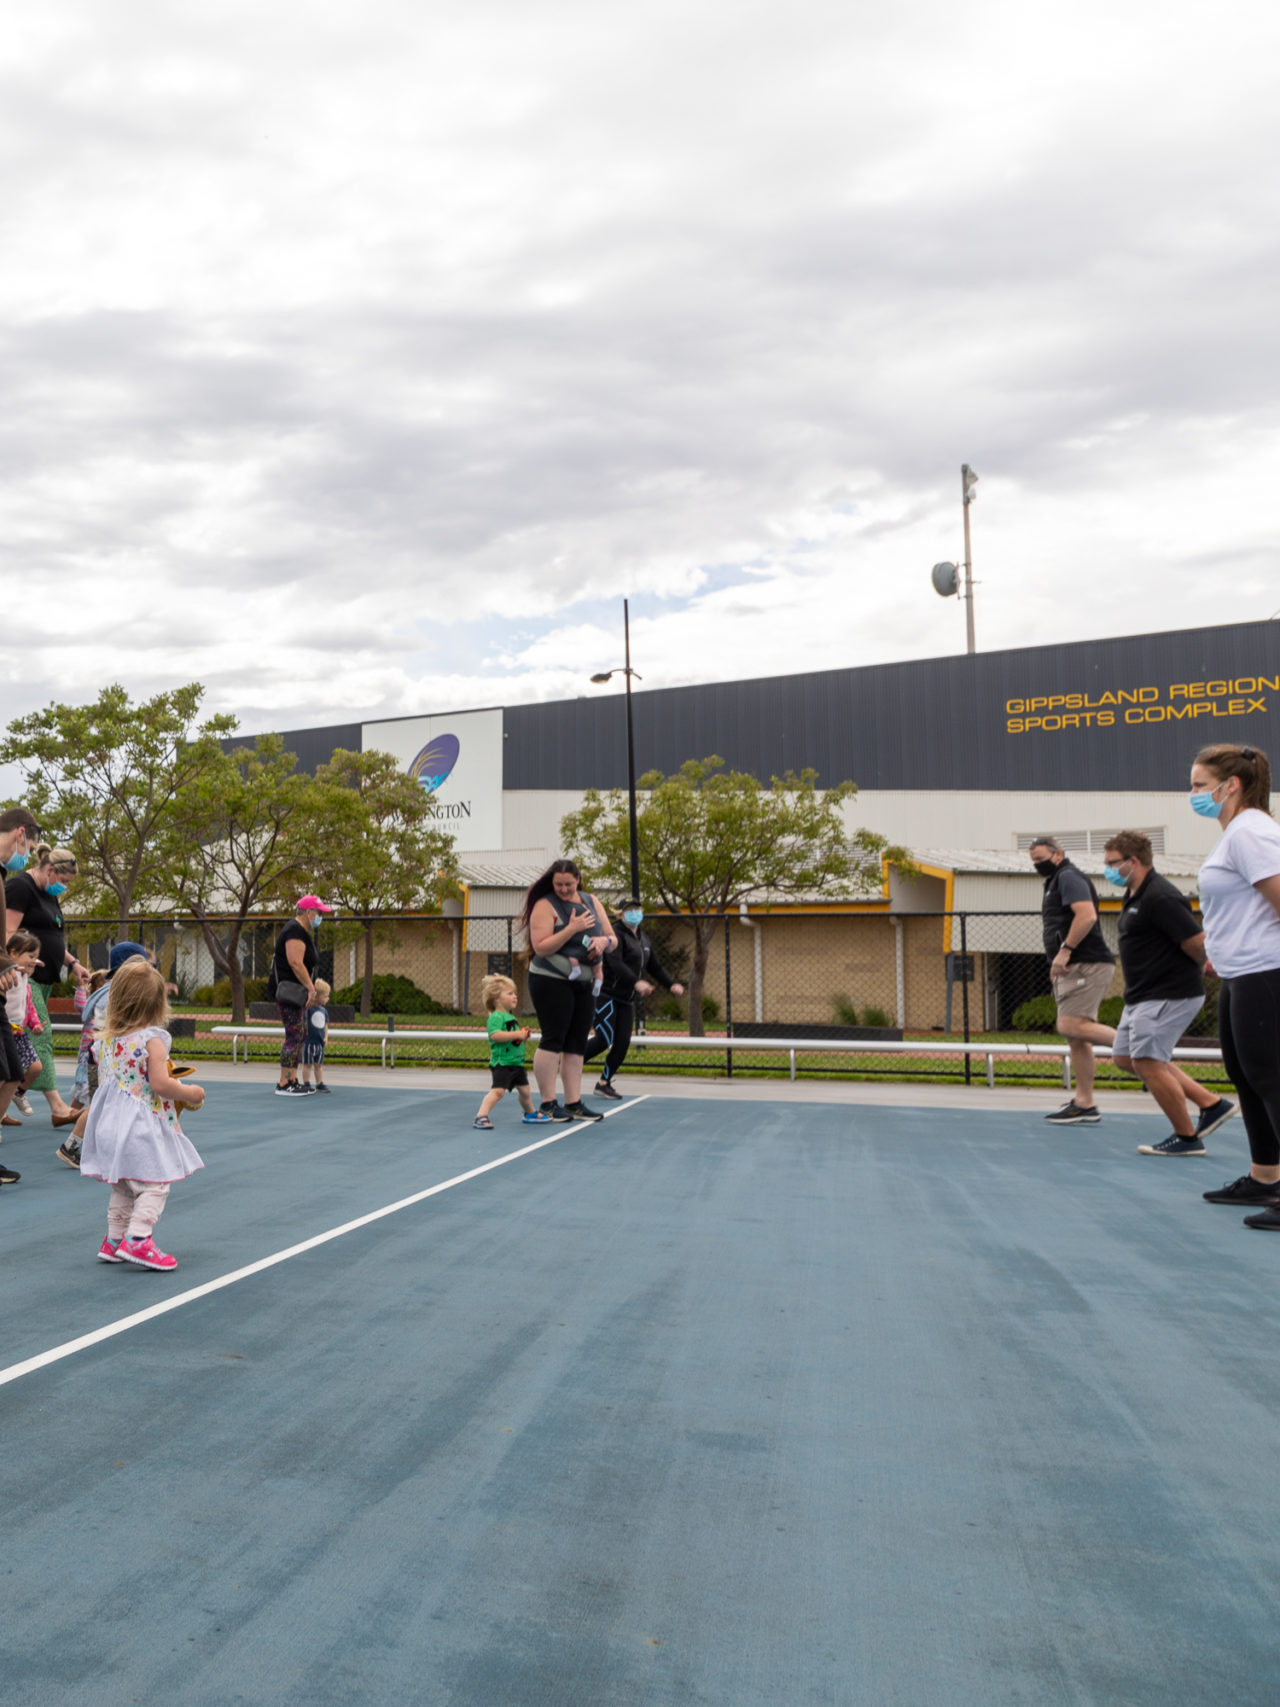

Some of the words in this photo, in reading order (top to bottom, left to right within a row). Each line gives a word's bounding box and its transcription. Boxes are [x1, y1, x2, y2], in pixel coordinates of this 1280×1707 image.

[1006, 687, 1159, 714] GIPPSLAND
[1170, 675, 1280, 700] REGION
[1007, 710, 1115, 734] SPORTS
[1124, 696, 1268, 724] COMPLEX
